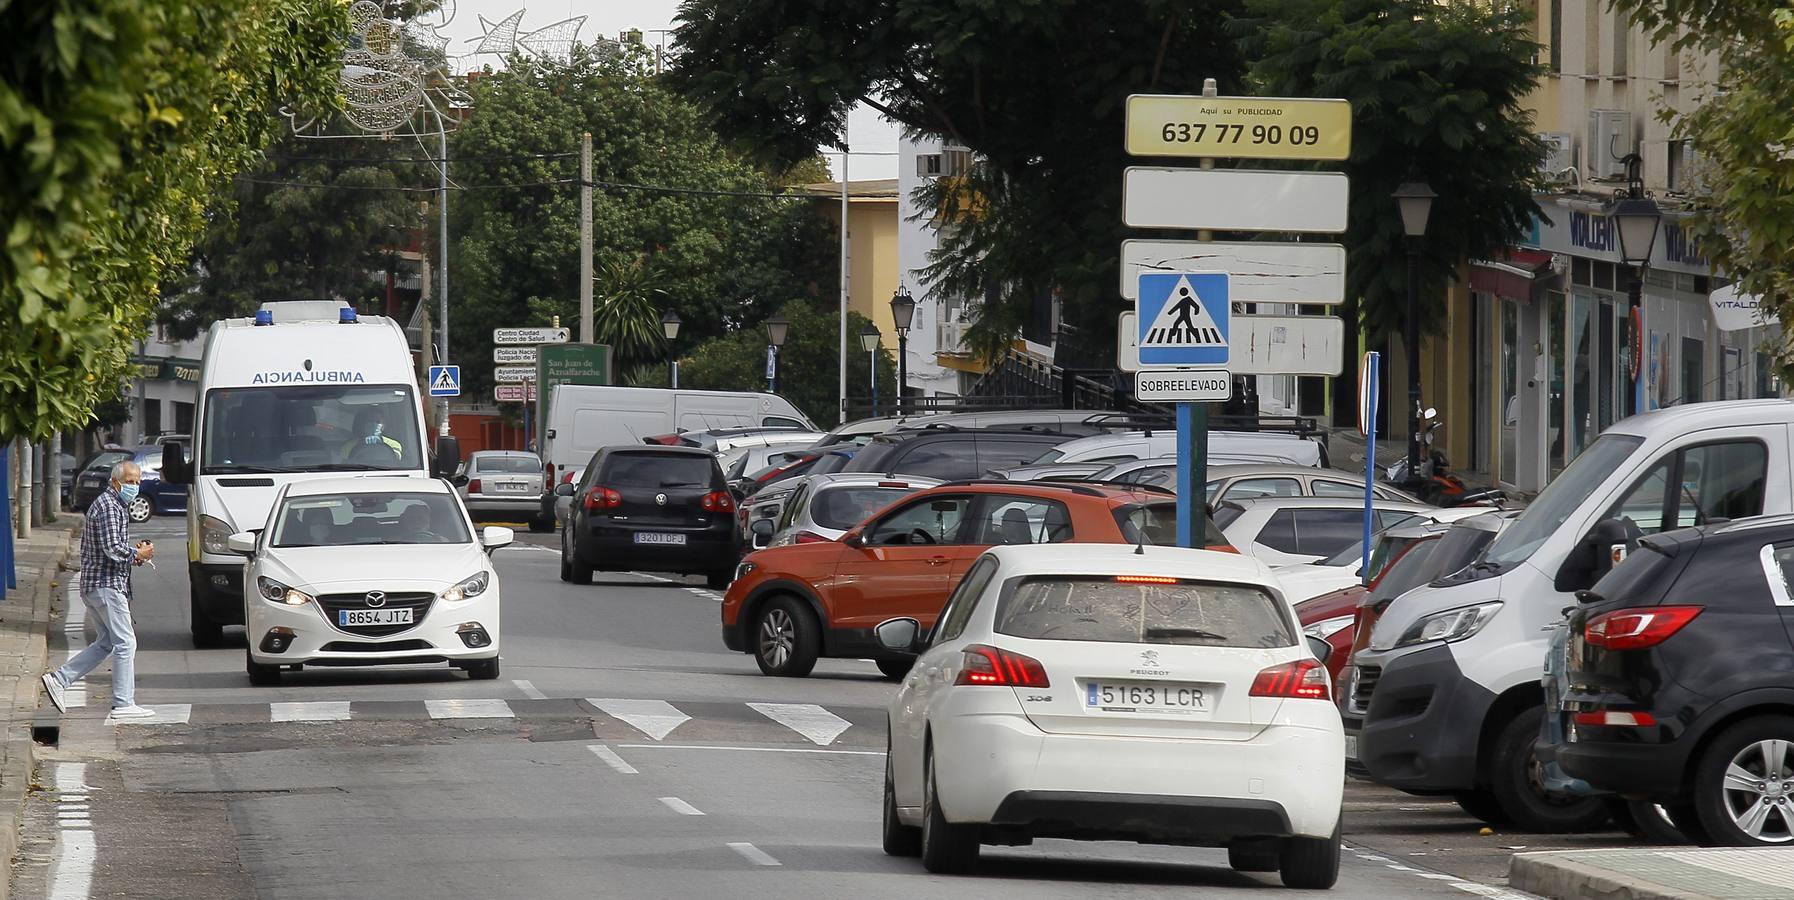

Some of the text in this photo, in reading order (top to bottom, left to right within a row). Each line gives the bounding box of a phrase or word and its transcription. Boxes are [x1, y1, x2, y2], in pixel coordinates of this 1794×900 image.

[1237, 108, 1283, 116] PUBLICIDAD
[1162, 123, 1319, 146] 637 77 90 09
[1715, 301, 1761, 309] VITALD
[565, 360, 582, 368] Juan
[1140, 379, 1226, 392] SOBREELEVADO
[349, 610, 409, 624] 8654 JTZ
[1102, 686, 1203, 707] 5163 LCR
